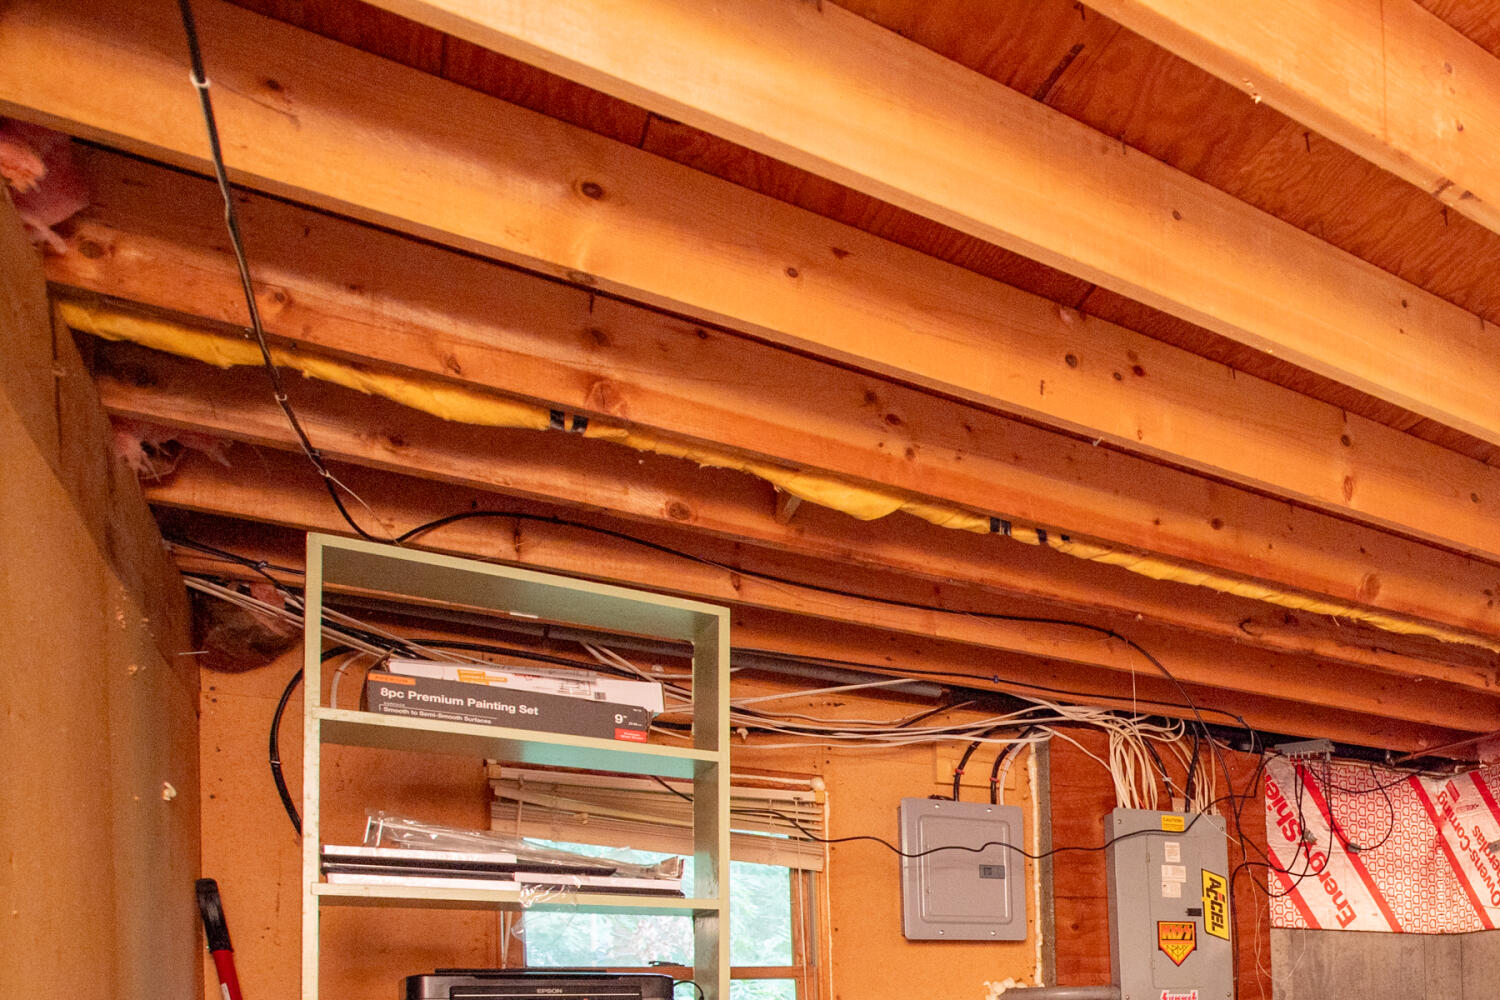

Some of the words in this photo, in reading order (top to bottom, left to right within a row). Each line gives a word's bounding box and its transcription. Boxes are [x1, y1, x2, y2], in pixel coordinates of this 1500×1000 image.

[380, 687, 405, 700] 8pc
[408, 690, 464, 706] Premium
[467, 697, 516, 714] Painting
[519, 704, 539, 715] Set
[383, 706, 409, 715] Smooth
[419, 711, 463, 721] Semi-Smooth
[1206, 877, 1226, 932] ACCEL
